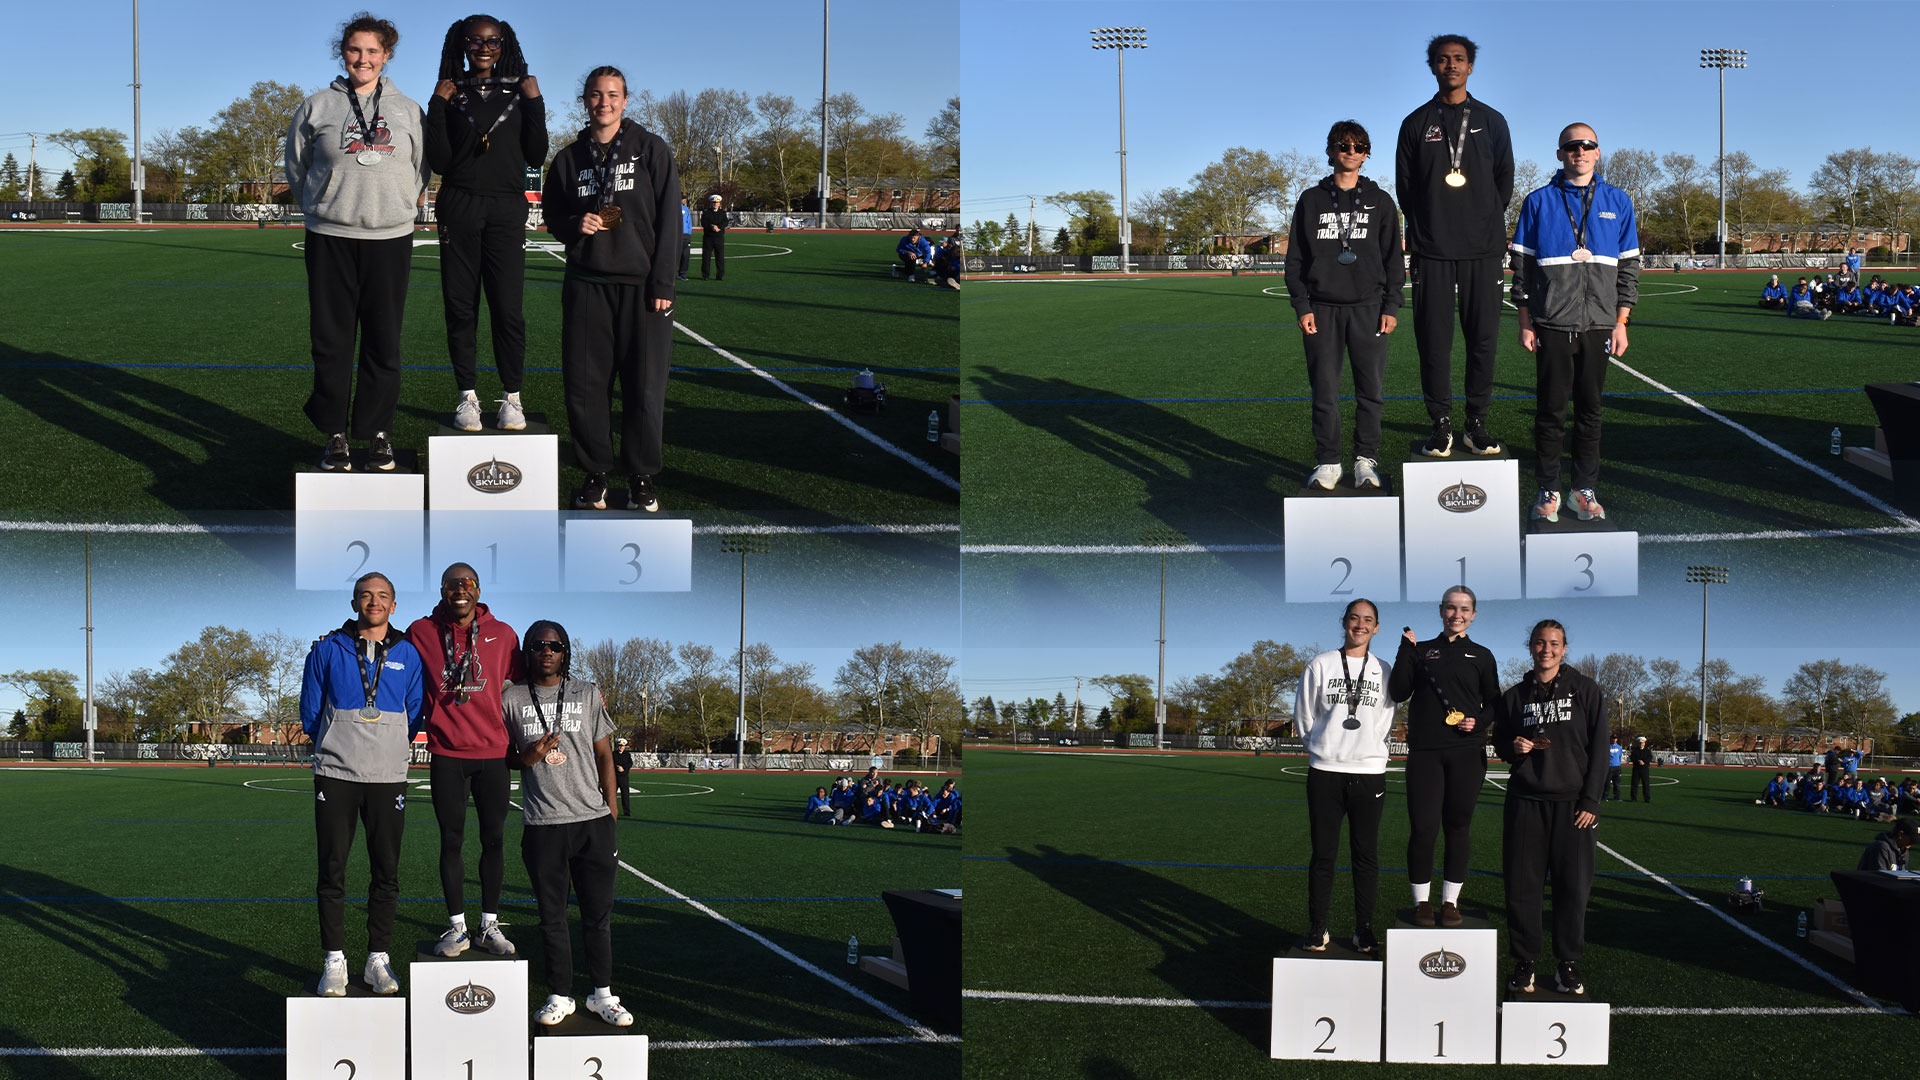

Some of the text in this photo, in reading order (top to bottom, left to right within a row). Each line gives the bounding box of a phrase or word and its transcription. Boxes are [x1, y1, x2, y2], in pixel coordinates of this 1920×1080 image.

[613, 178, 634, 191] IELD
[1316, 228, 1340, 240] TRACK
[1445, 499, 1480, 507] SKYLINE
[345, 540, 371, 583] 2
[486, 542, 500, 585] 1
[618, 542, 643, 585] 3
[1330, 557, 1354, 595] 2
[1455, 556, 1467, 589] 1
[1573, 553, 1595, 592] 3
[1313, 1016, 1336, 1054] 2
[1433, 1020, 1447, 1057] 1
[1546, 1022, 1568, 1059] 3
[462, 1059, 473, 1080] 1
[583, 1056, 604, 1080] 3
